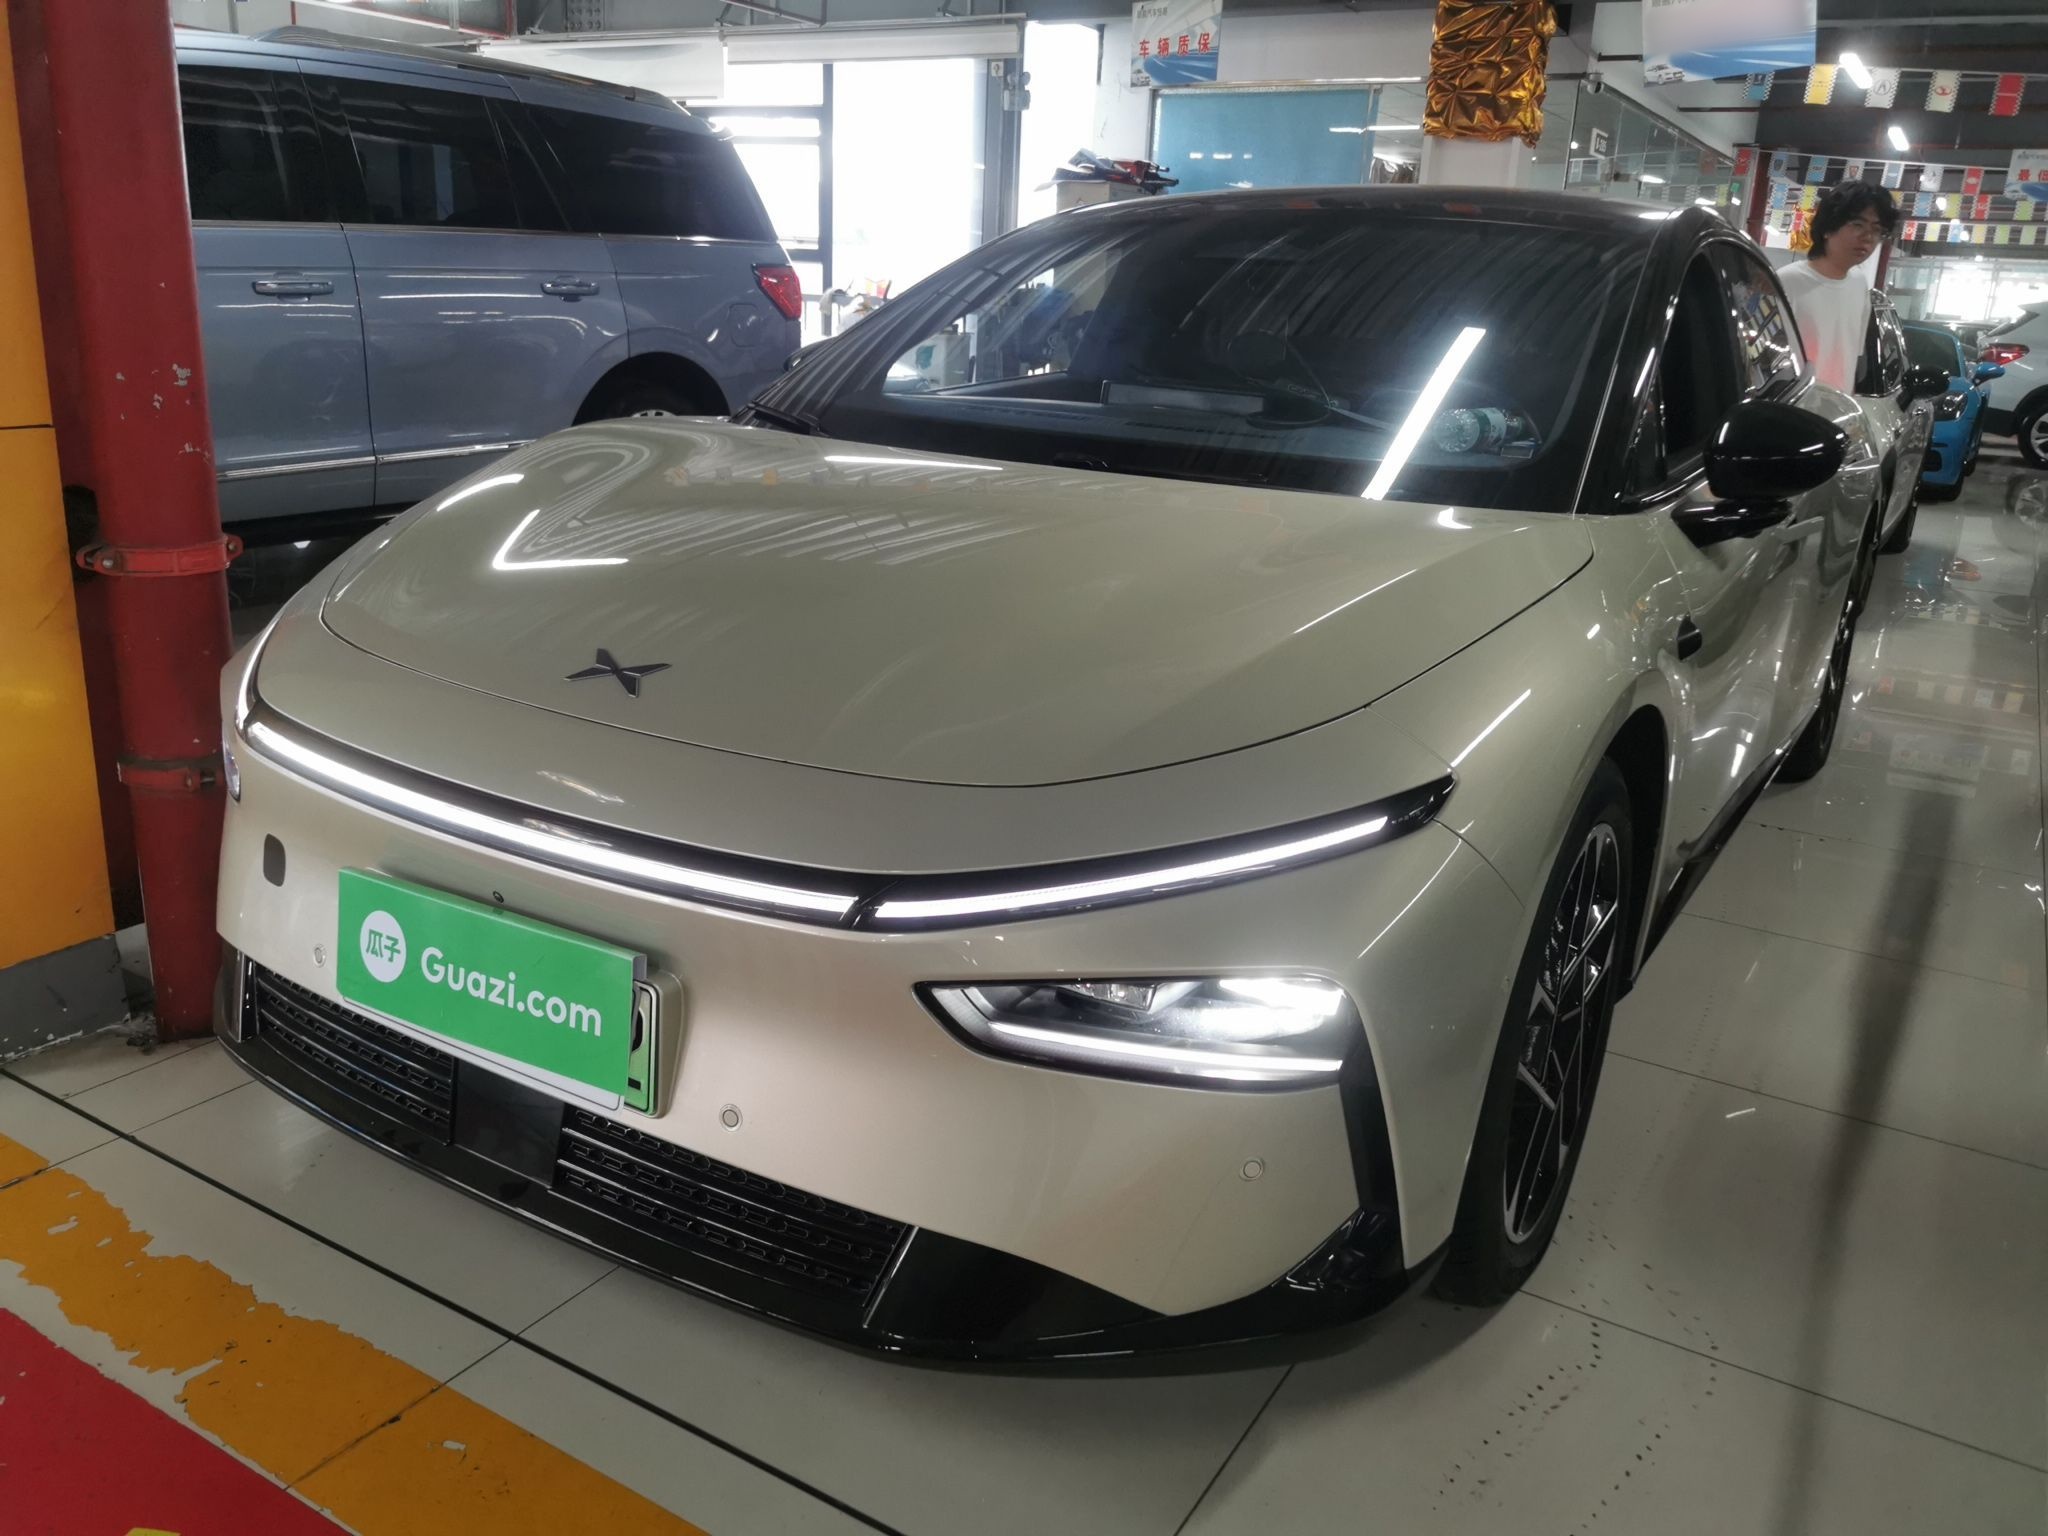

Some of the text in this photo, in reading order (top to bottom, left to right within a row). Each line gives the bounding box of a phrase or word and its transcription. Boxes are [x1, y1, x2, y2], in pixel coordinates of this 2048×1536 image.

[1138, 32, 1211, 59] 车辆质保
[366, 928, 401, 962] 瓜子
[421, 946, 602, 1037] Guazi.com
